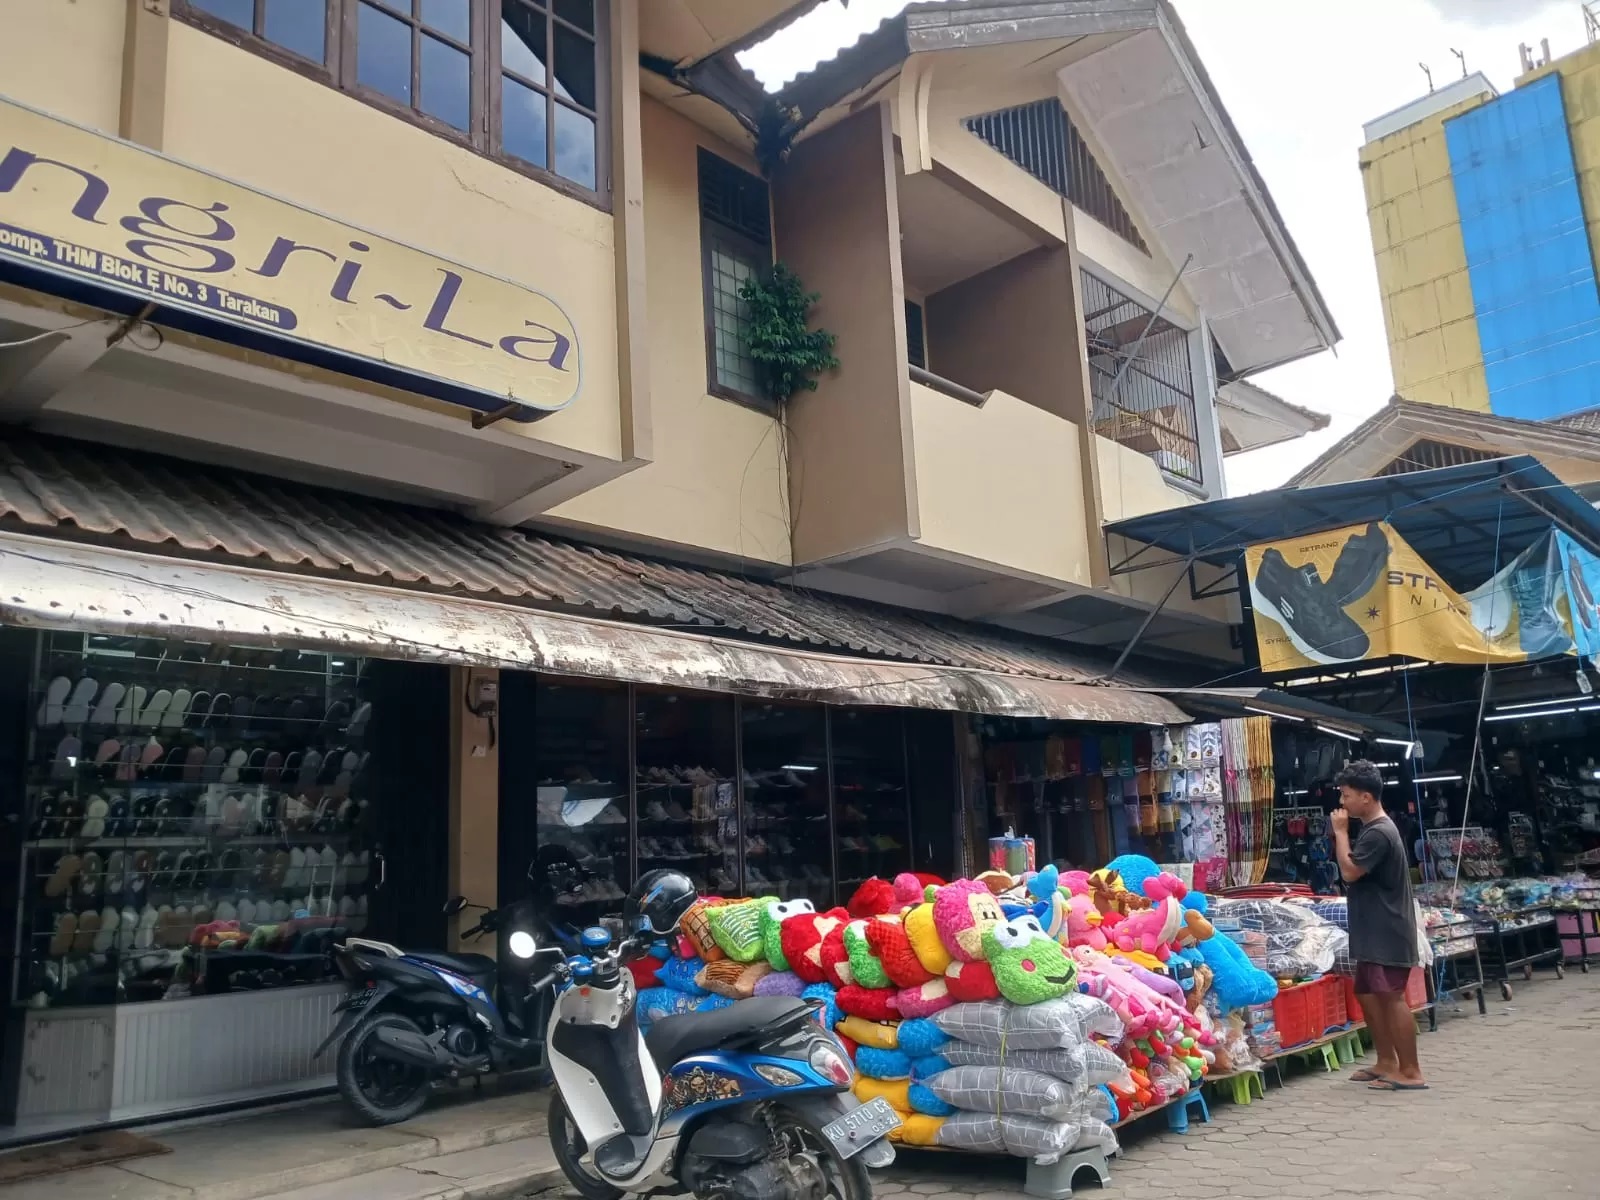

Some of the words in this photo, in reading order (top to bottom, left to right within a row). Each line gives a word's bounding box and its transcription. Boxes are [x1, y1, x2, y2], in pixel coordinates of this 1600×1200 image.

[53, 240, 97, 270] THM
[102, 255, 143, 284] Blok
[147, 269, 160, 288] E
[164, 275, 193, 299] No.
[197, 284, 208, 302] 3
[217, 289, 280, 323] Tarakan
[825, 1123, 845, 1141] KU
[845, 1107, 874, 1130] 5710
